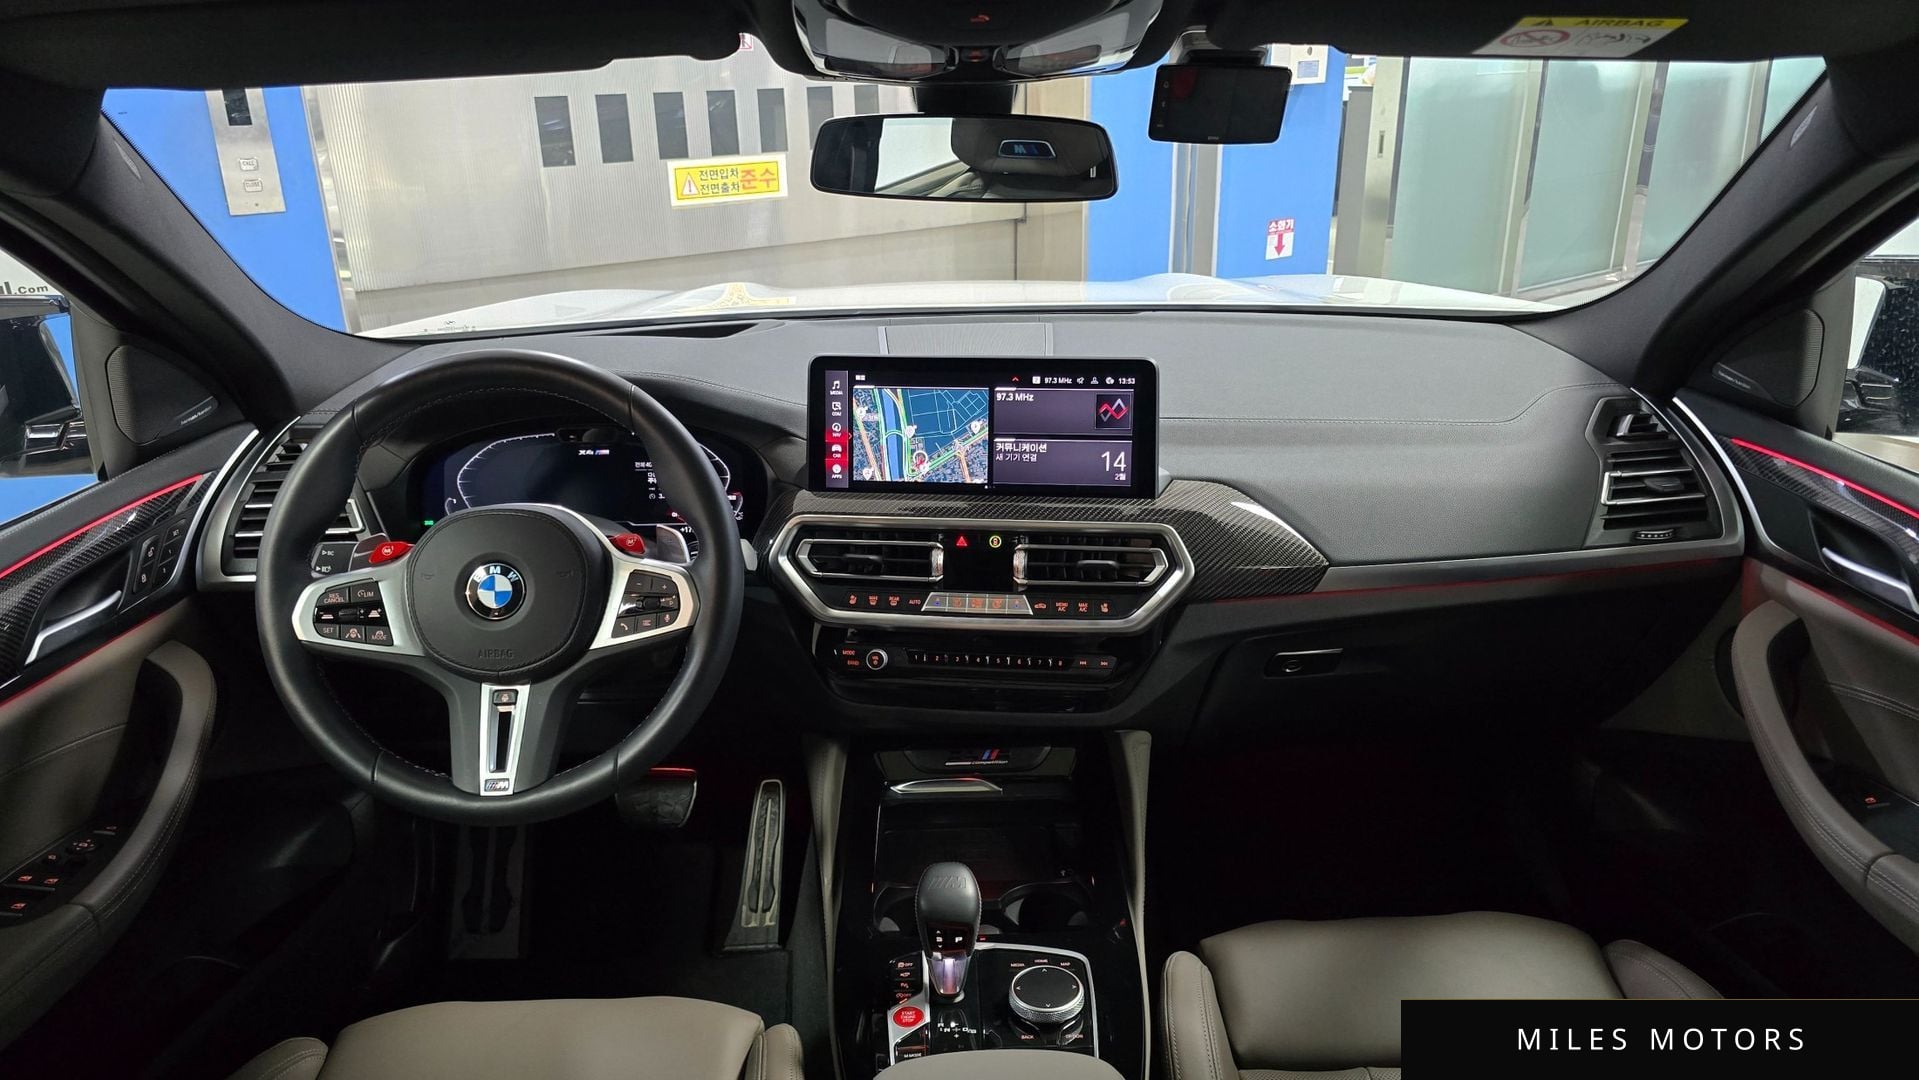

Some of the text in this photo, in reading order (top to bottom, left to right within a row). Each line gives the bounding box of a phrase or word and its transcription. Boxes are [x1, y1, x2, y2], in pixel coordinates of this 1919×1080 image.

[1575, 19, 1665, 27] AIRBAG
[699, 167, 739, 181] 전면입차
[741, 168, 777, 190] 준수
[700, 181, 740, 195] 전면출차
[1058, 377, 1072, 385] MHz
[996, 392, 1034, 402] 97.3 MHz
[995, 442, 1047, 453] 커뮤니케이션
[995, 453, 1003, 461] 새
[1005, 453, 1020, 462] 기기
[1101, 451, 1126, 472] 14
[473, 565, 520, 583] BMW
[478, 648, 514, 659] AIRBAG
